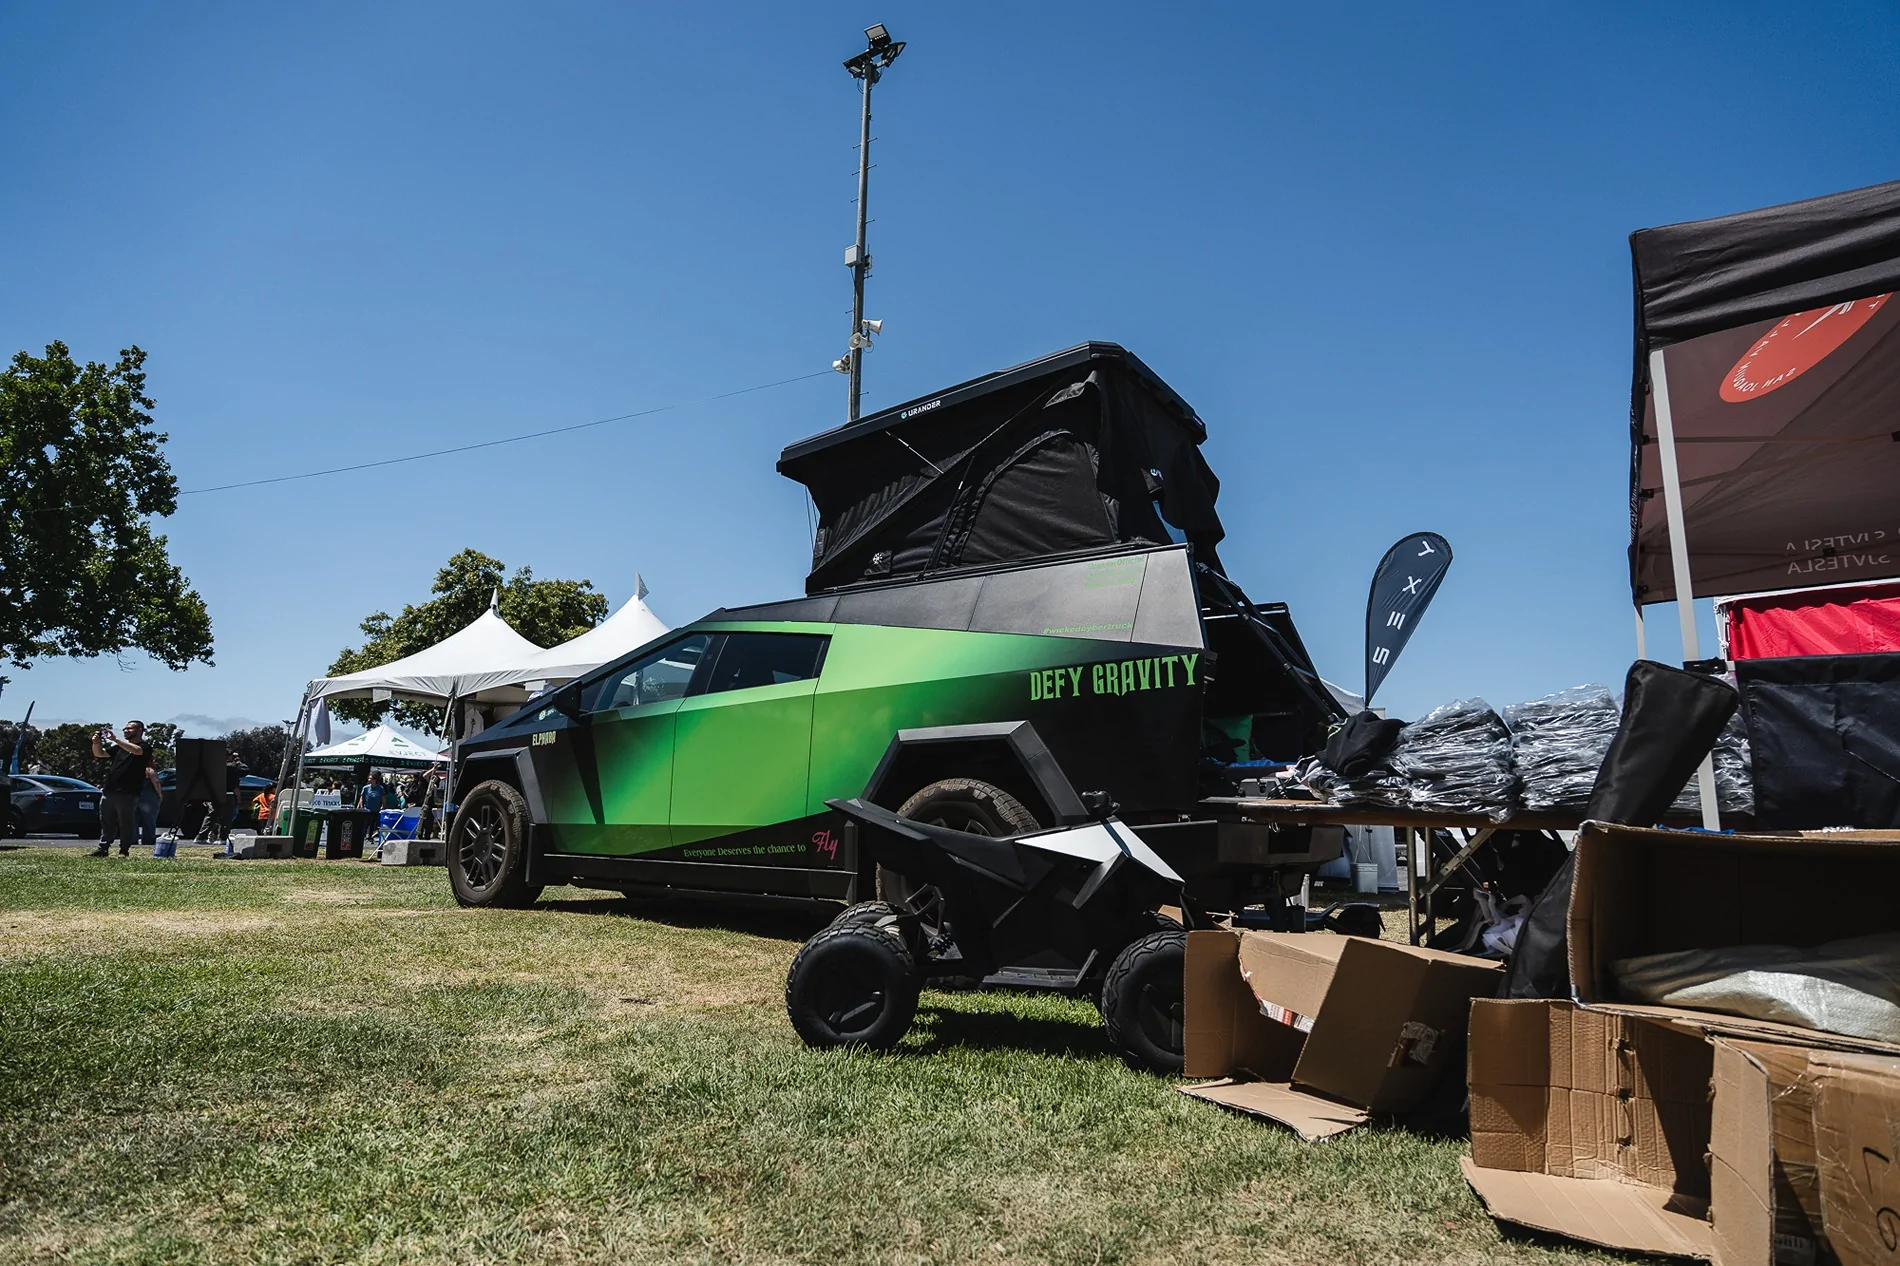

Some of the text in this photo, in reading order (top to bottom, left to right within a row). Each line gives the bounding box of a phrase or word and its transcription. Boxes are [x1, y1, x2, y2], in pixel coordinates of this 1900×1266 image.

[908, 400, 941, 417] URANDER
[1030, 653, 1199, 700] DEFY GRAVITY
[684, 829, 839, 860] Everyone Deserves the chance to Fly
